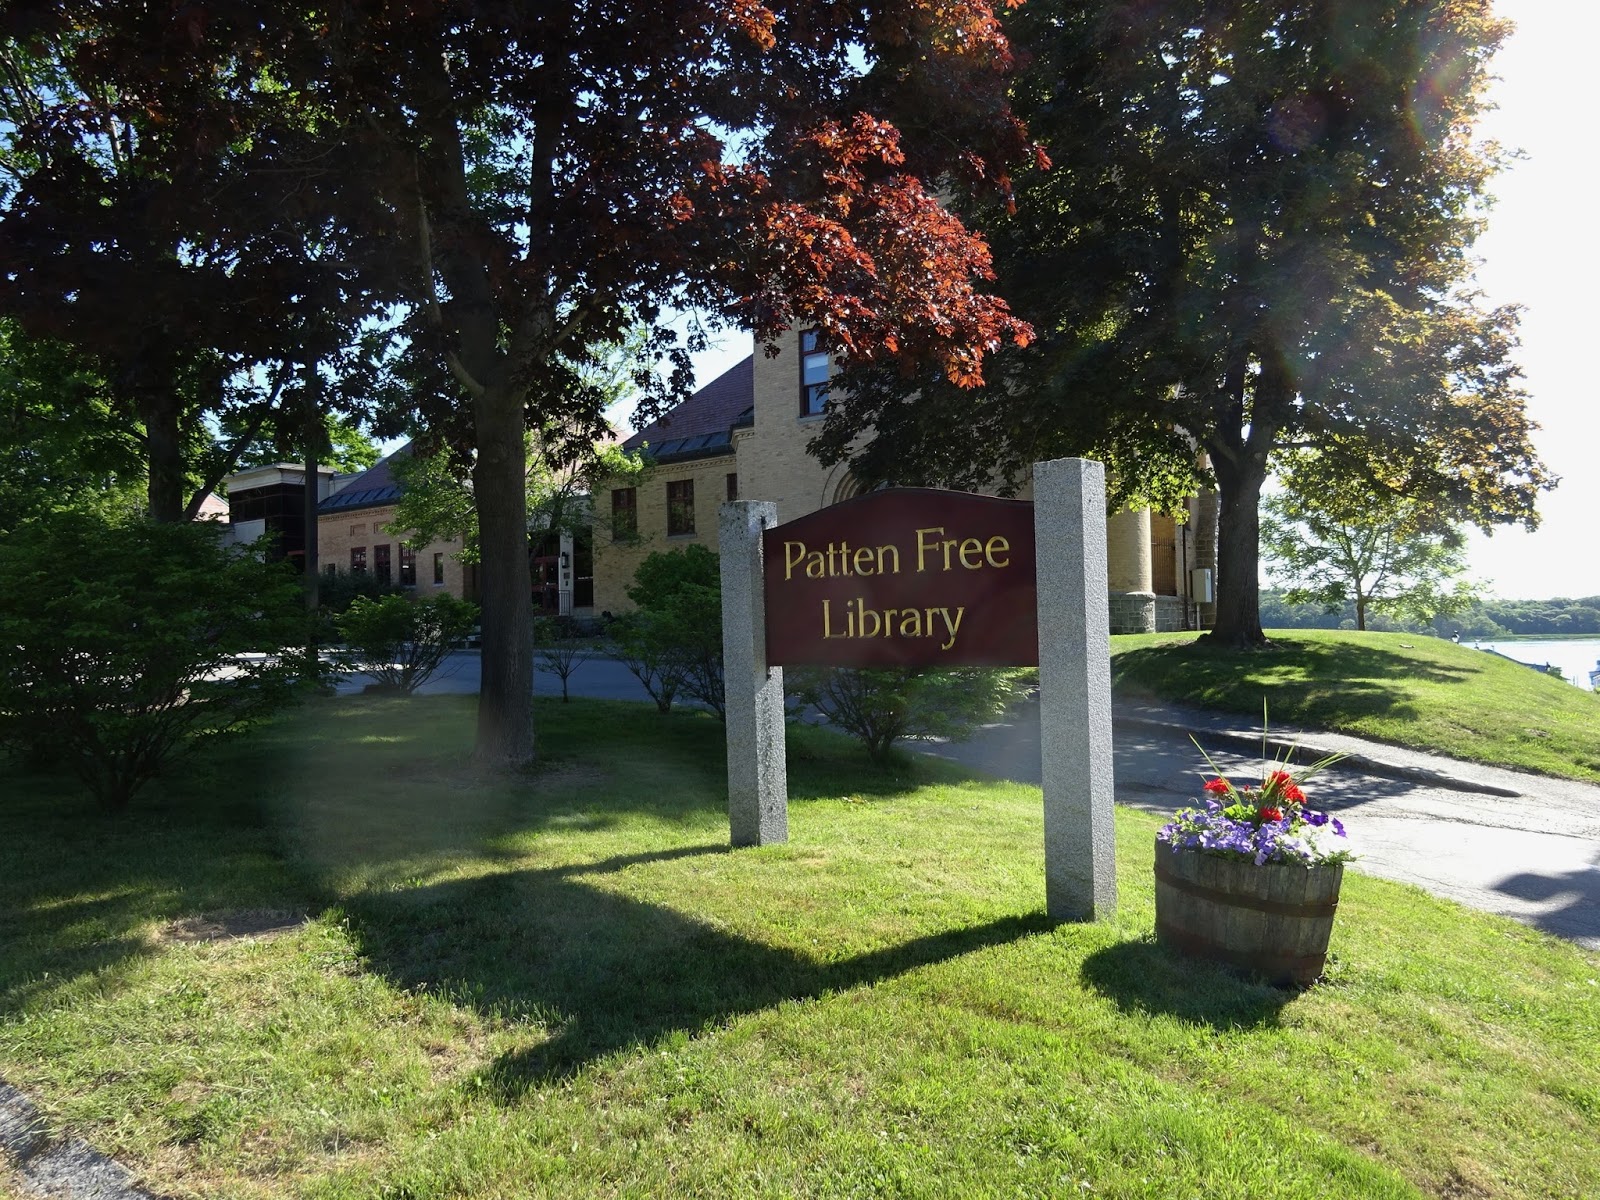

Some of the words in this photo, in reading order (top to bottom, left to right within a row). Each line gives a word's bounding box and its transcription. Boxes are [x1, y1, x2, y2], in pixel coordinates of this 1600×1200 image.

[783, 541, 900, 581] Patten
[915, 527, 1010, 573] Free
[822, 598, 965, 650] Library
